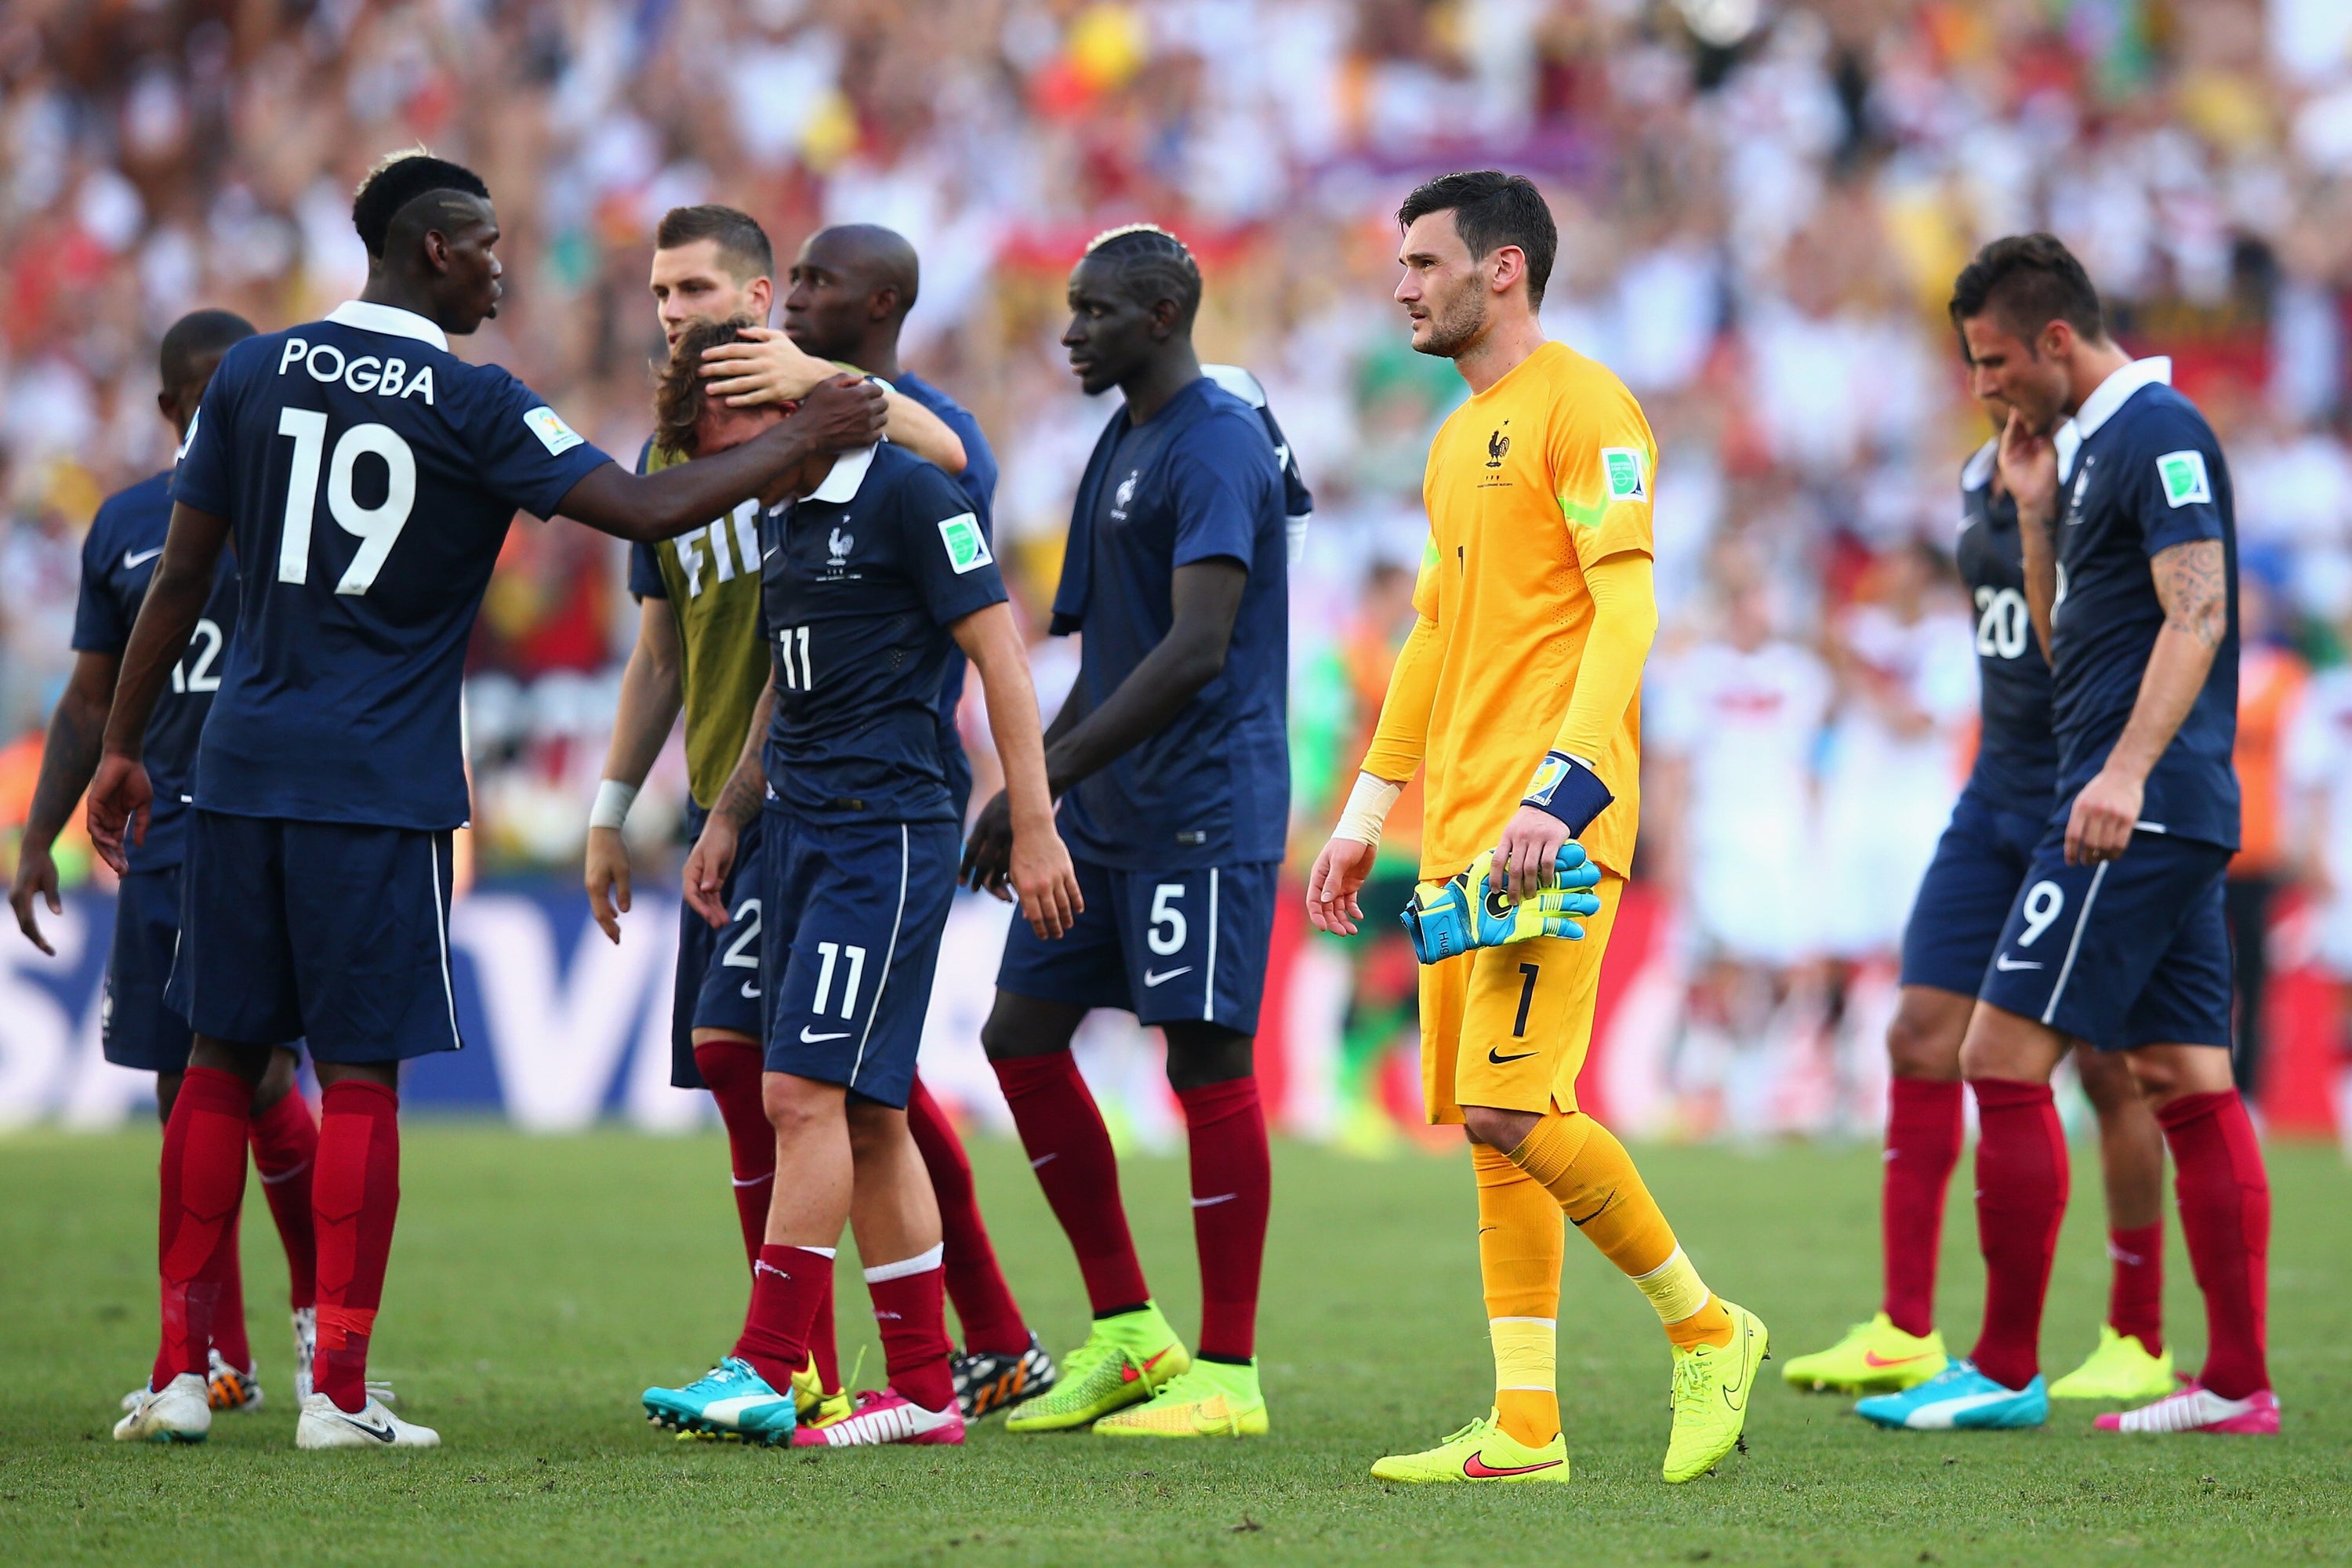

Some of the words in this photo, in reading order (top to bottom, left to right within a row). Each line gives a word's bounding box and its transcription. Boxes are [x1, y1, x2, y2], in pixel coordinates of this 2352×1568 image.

[278, 337, 434, 405] POGBA
[278, 405, 417, 596] 19
[1974, 584, 2030, 659] 20
[779, 626, 811, 691] 11
[1147, 884, 1188, 956] 5
[2017, 880, 2066, 948] 9
[812, 942, 866, 1020] 11
[1512, 962, 1540, 1037] 1
